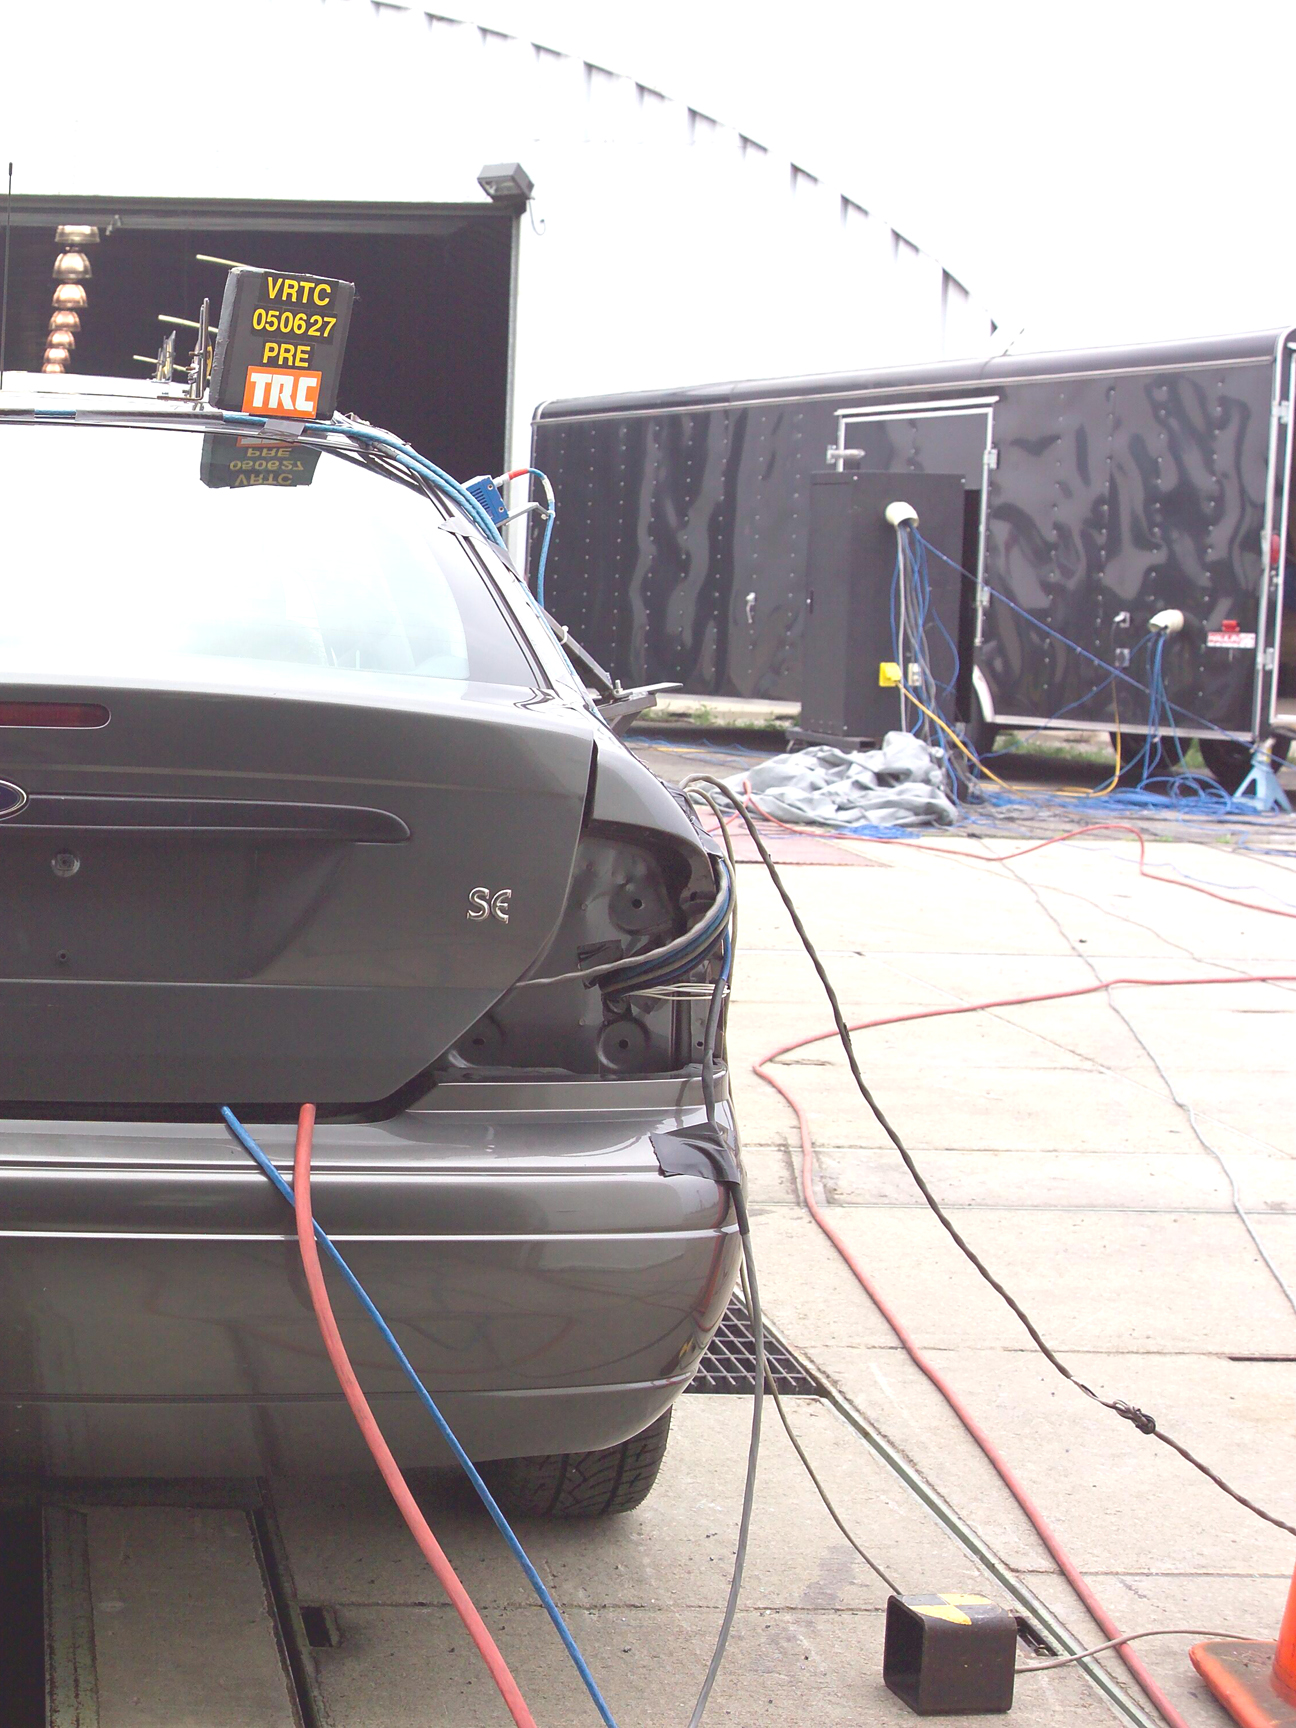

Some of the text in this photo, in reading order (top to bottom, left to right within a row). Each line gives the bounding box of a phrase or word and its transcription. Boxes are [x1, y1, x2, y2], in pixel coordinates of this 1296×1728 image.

[267, 276, 332, 306] VRTC
[252, 308, 337, 337] 050627
[262, 342, 311, 367] PRE
[250, 372, 318, 412] TRC
[466, 886, 512, 924] SE
